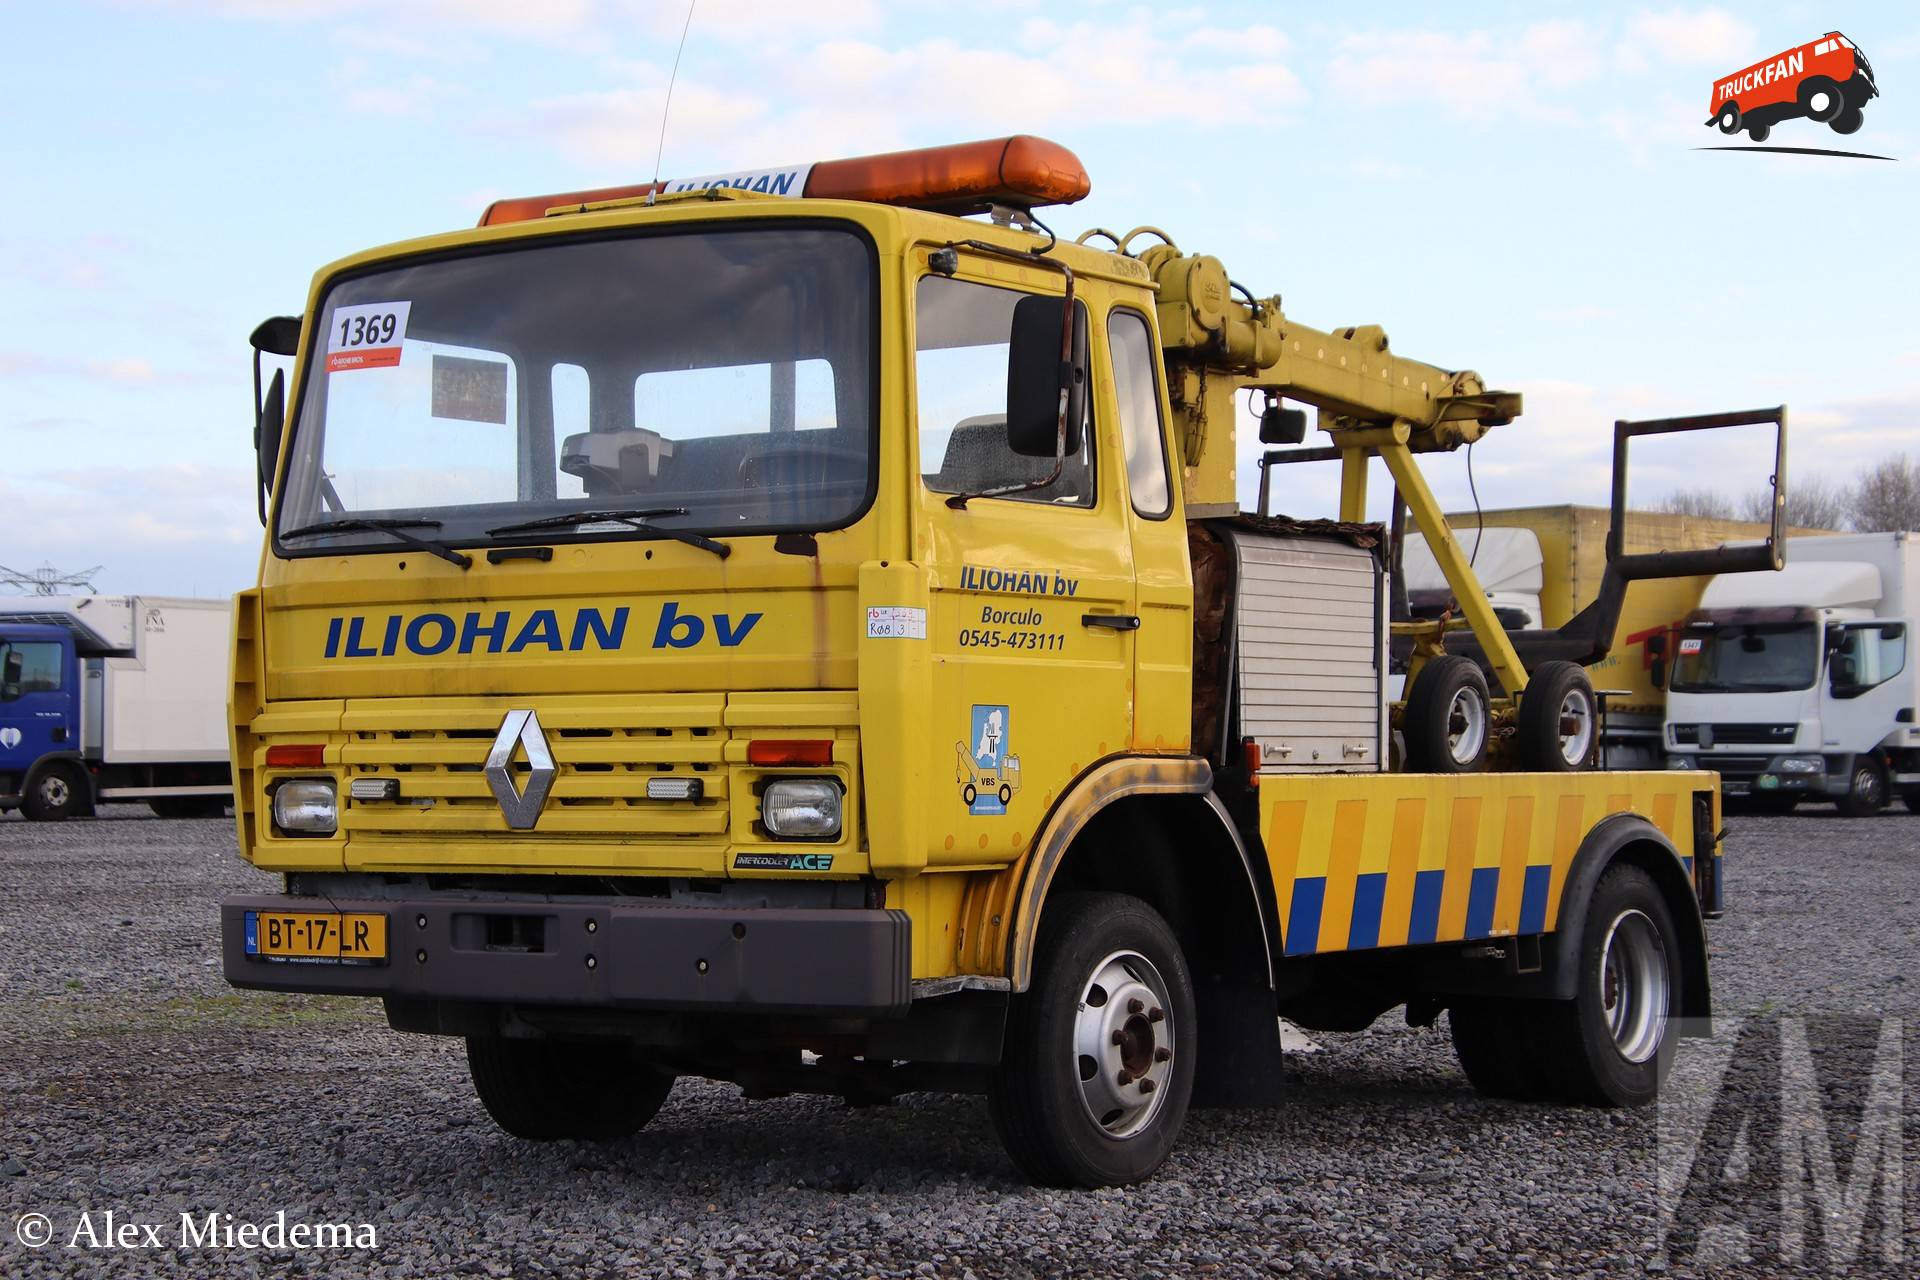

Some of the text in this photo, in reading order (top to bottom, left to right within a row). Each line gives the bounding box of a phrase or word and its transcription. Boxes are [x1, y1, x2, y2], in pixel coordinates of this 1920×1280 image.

[341, 313, 397, 347] 1369
[960, 565, 1078, 596] ILIOHAN bv
[981, 606, 1042, 626] Borculo
[324, 602, 764, 658] ILIOHAN bv
[960, 629, 1065, 650] 0545-473111
[1771, 727, 1795, 735] LF
[981, 777, 996, 786] VBS
[790, 854, 832, 870] ACE
[247, 936, 257, 946] NL
[268, 918, 370, 951] BT-17-LR
